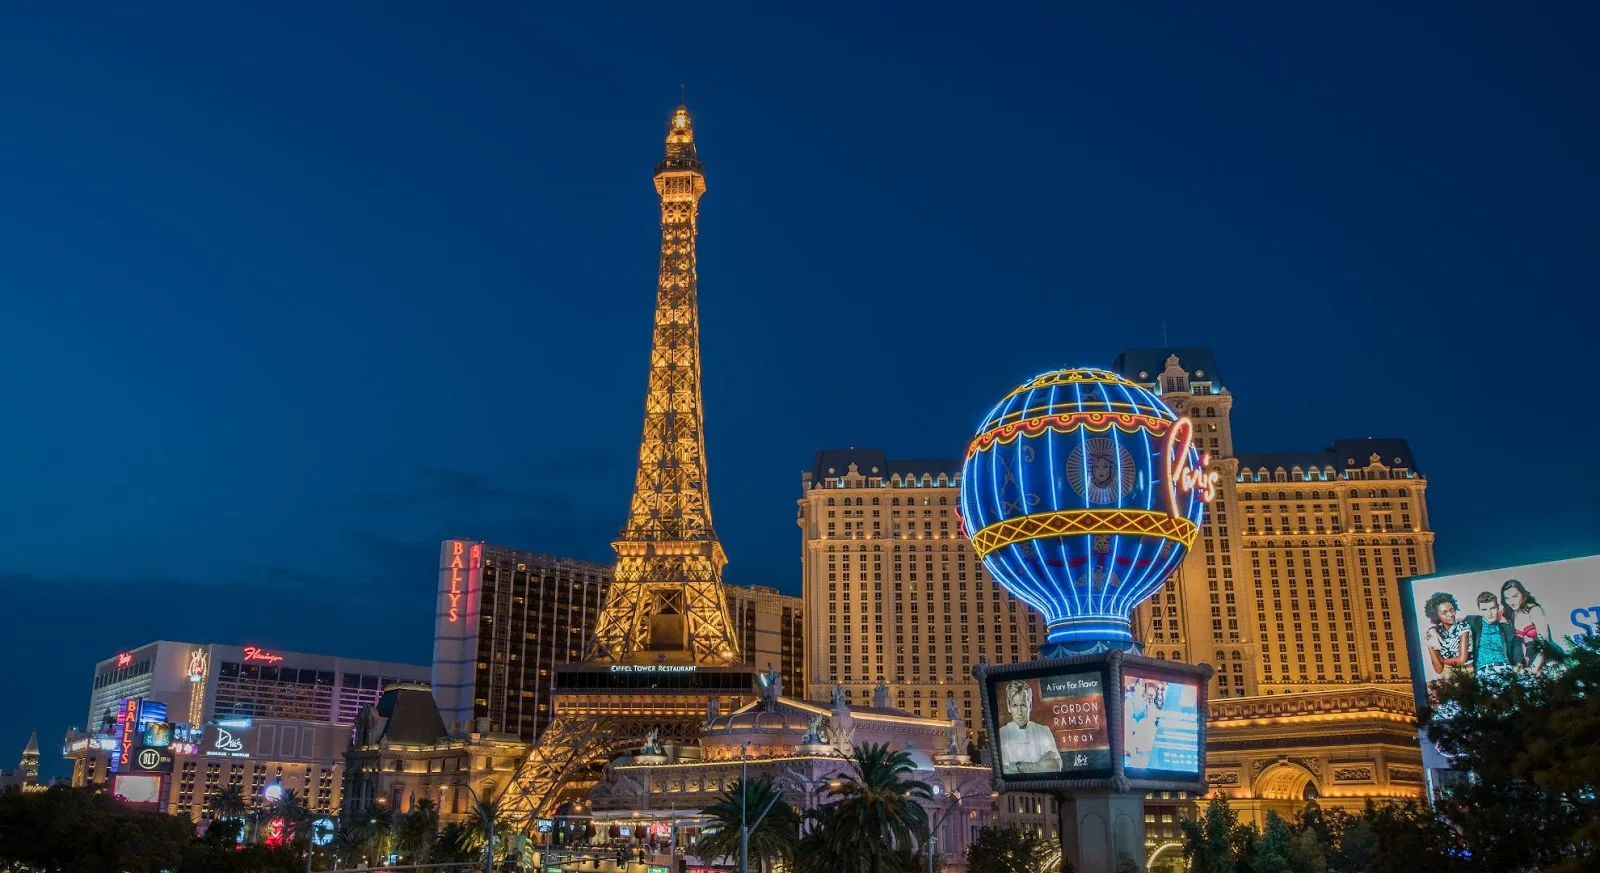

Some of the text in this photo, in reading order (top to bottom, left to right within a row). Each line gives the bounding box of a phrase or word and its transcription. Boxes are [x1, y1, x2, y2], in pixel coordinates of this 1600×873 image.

[1166, 417, 1219, 519] Paris
[244, 647, 283, 663] Flamingo
[1046, 680, 1098, 692] A Fury For Flavor
[1053, 702, 1098, 715] GORDON
[1053, 715, 1099, 727] RAMSAY
[1062, 733, 1094, 743] steak
[142, 752, 156, 766] BLT
